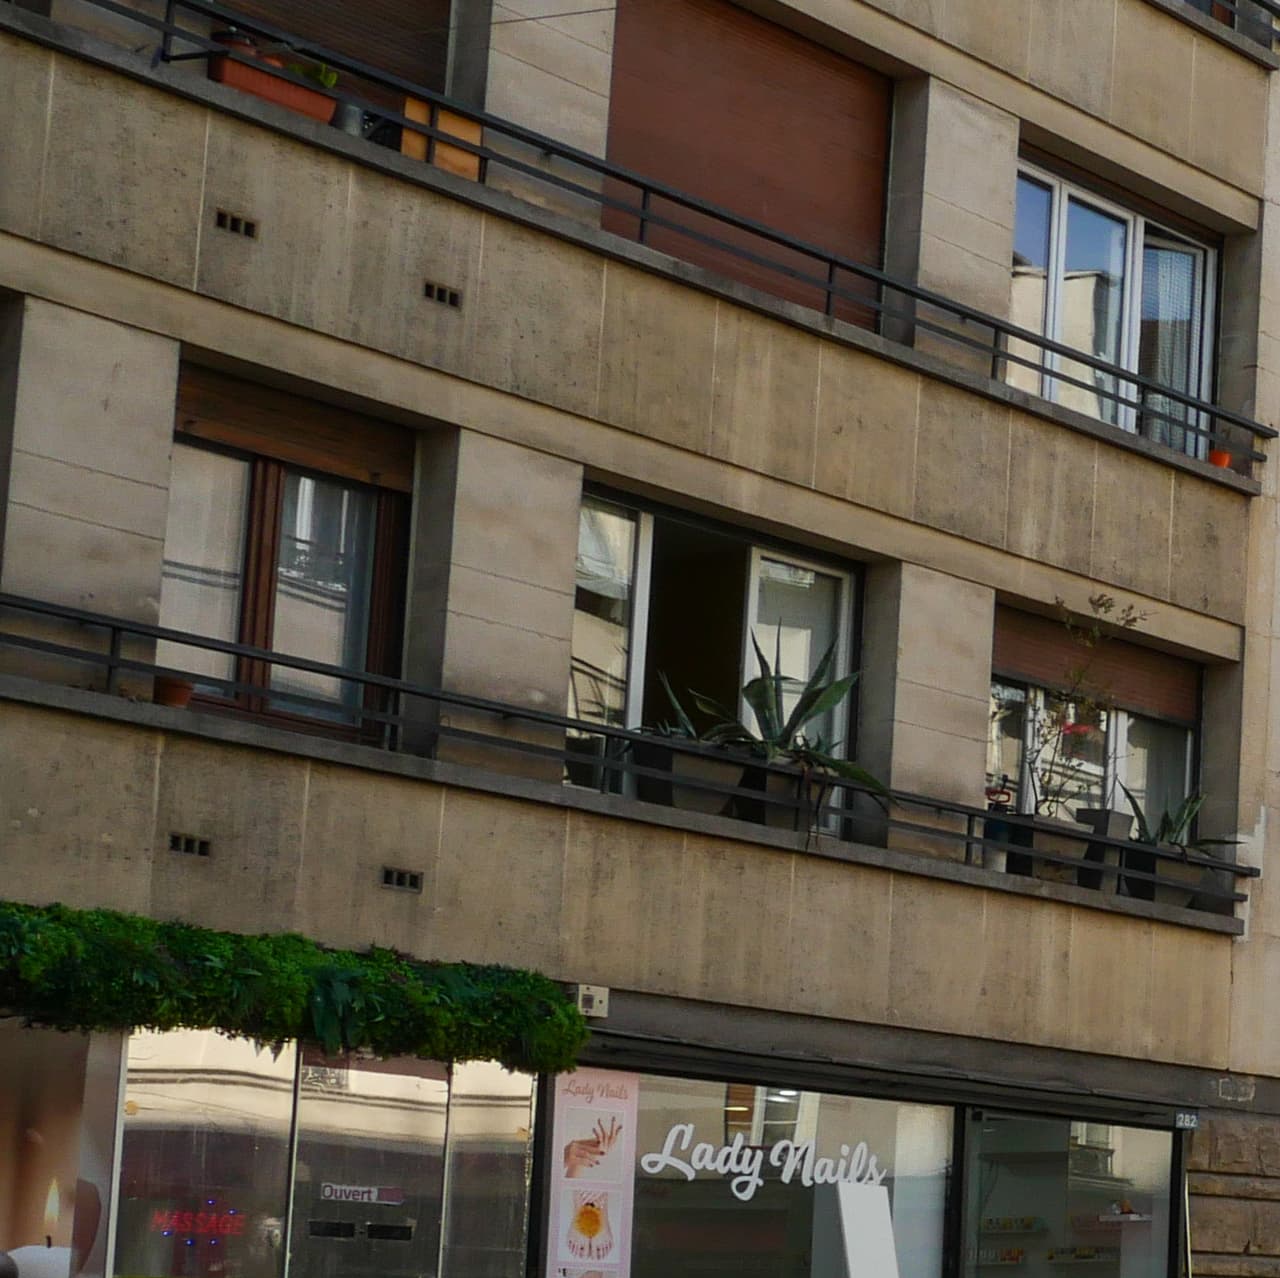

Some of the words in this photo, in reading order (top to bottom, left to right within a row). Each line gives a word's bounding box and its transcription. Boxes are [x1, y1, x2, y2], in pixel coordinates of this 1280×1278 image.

[560, 1079, 595, 1104] Lady
[597, 1082, 629, 1100] Nails
[1175, 1112, 1199, 1128] 282
[641, 1123, 764, 1201] Lady
[769, 1139, 887, 1187] Nails
[321, 1184, 374, 1201] Ouvert
[151, 1209, 247, 1236] MASSAGE
